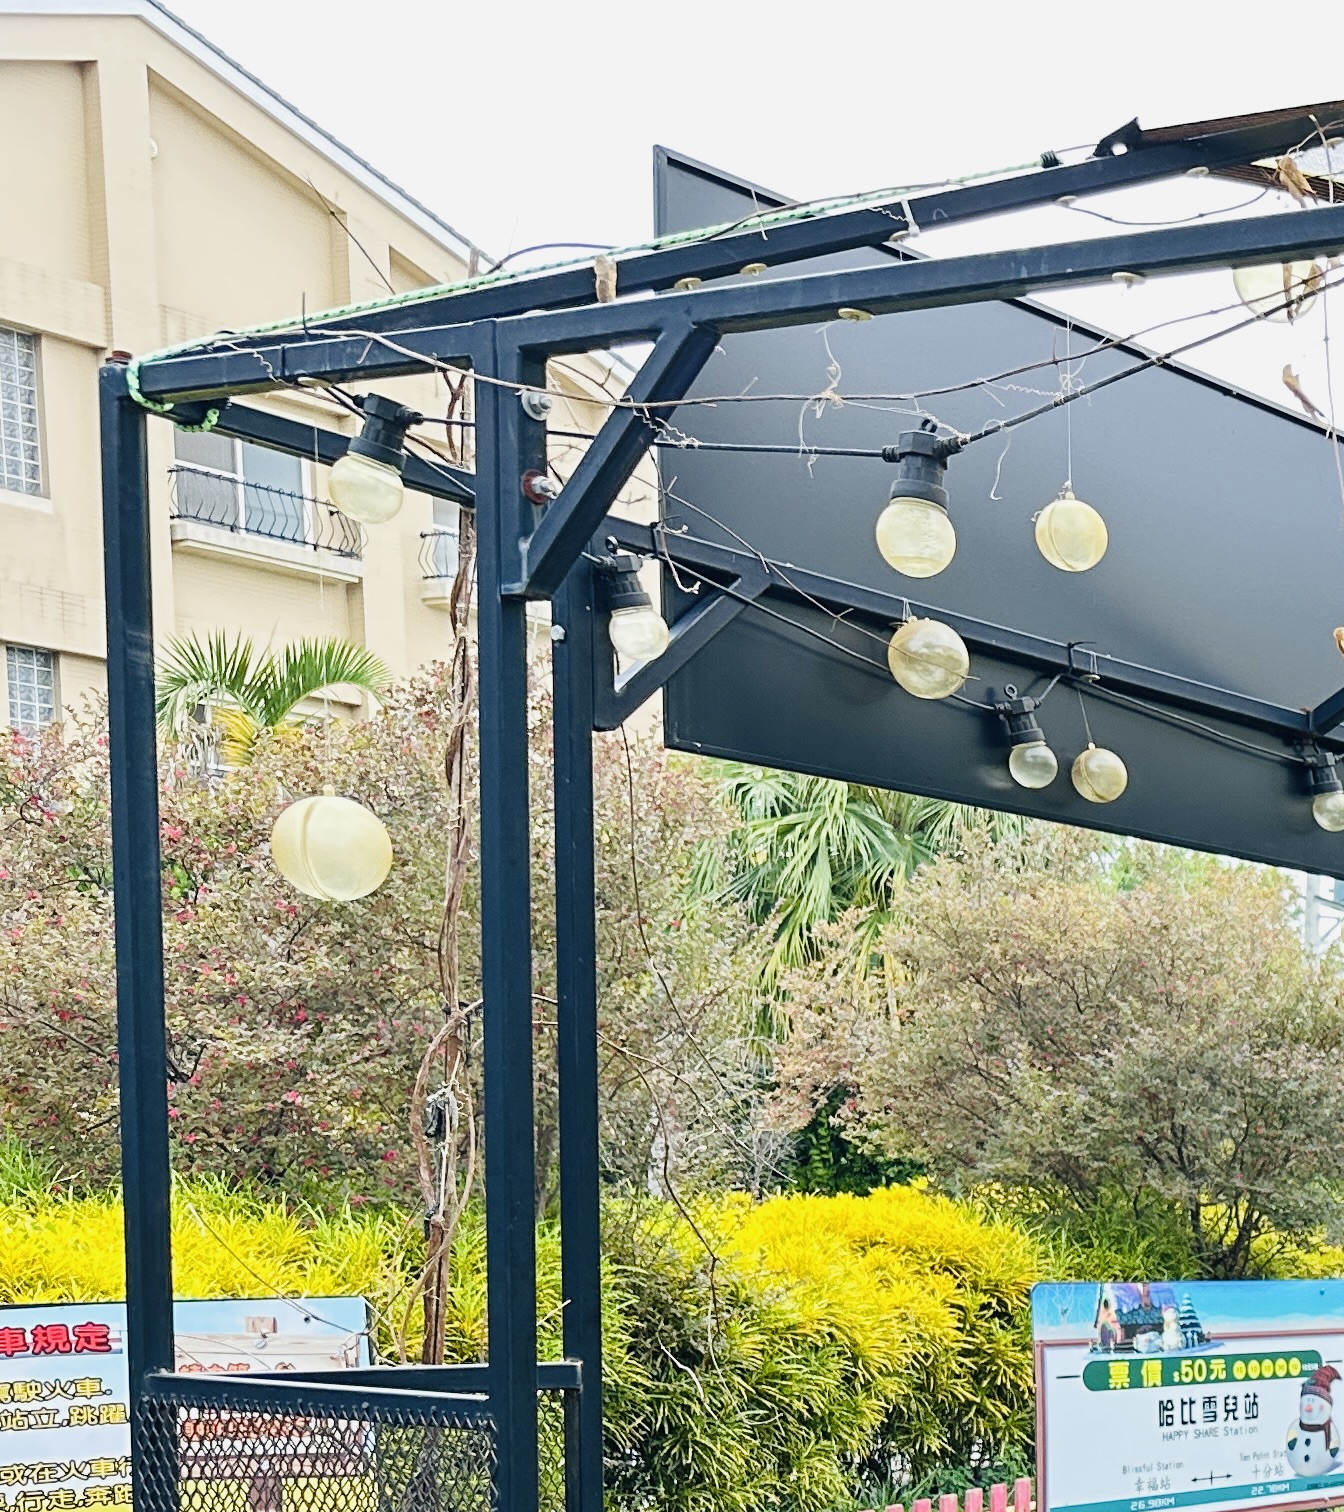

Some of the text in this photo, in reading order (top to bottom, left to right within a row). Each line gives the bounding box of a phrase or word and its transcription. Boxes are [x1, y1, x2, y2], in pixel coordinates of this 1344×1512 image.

[0, 1321, 112, 1357] 車規定
[1108, 1360, 1162, 1389] 票價
[1158, 1392, 1259, 1428] 哈比雪兒站
[1162, 1425, 1259, 1442] HAPPY SHARE Station
